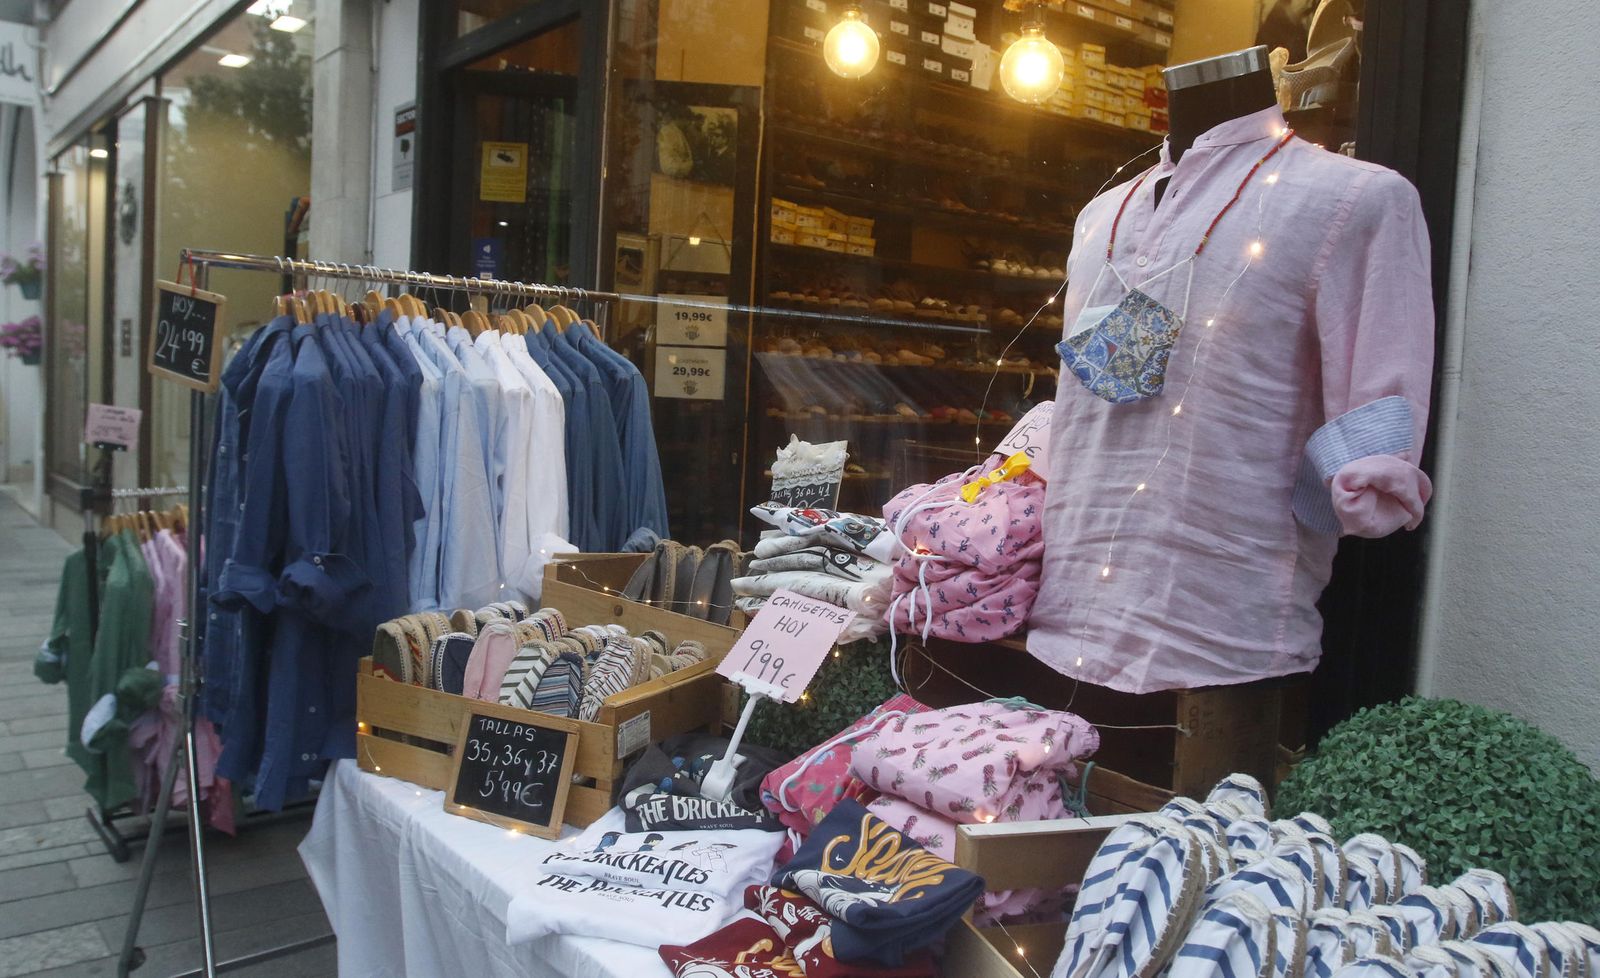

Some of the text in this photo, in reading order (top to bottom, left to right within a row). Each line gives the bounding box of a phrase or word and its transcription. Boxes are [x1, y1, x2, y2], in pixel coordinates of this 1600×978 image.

[674, 311, 713, 322] 19,99€
[672, 366, 712, 379] 29,99€
[772, 596, 849, 624] CAMISETAS
[773, 615, 809, 638] HOY
[479, 718, 537, 742] TALLAS
[635, 799, 669, 831] THE
[537, 874, 582, 893] THE
